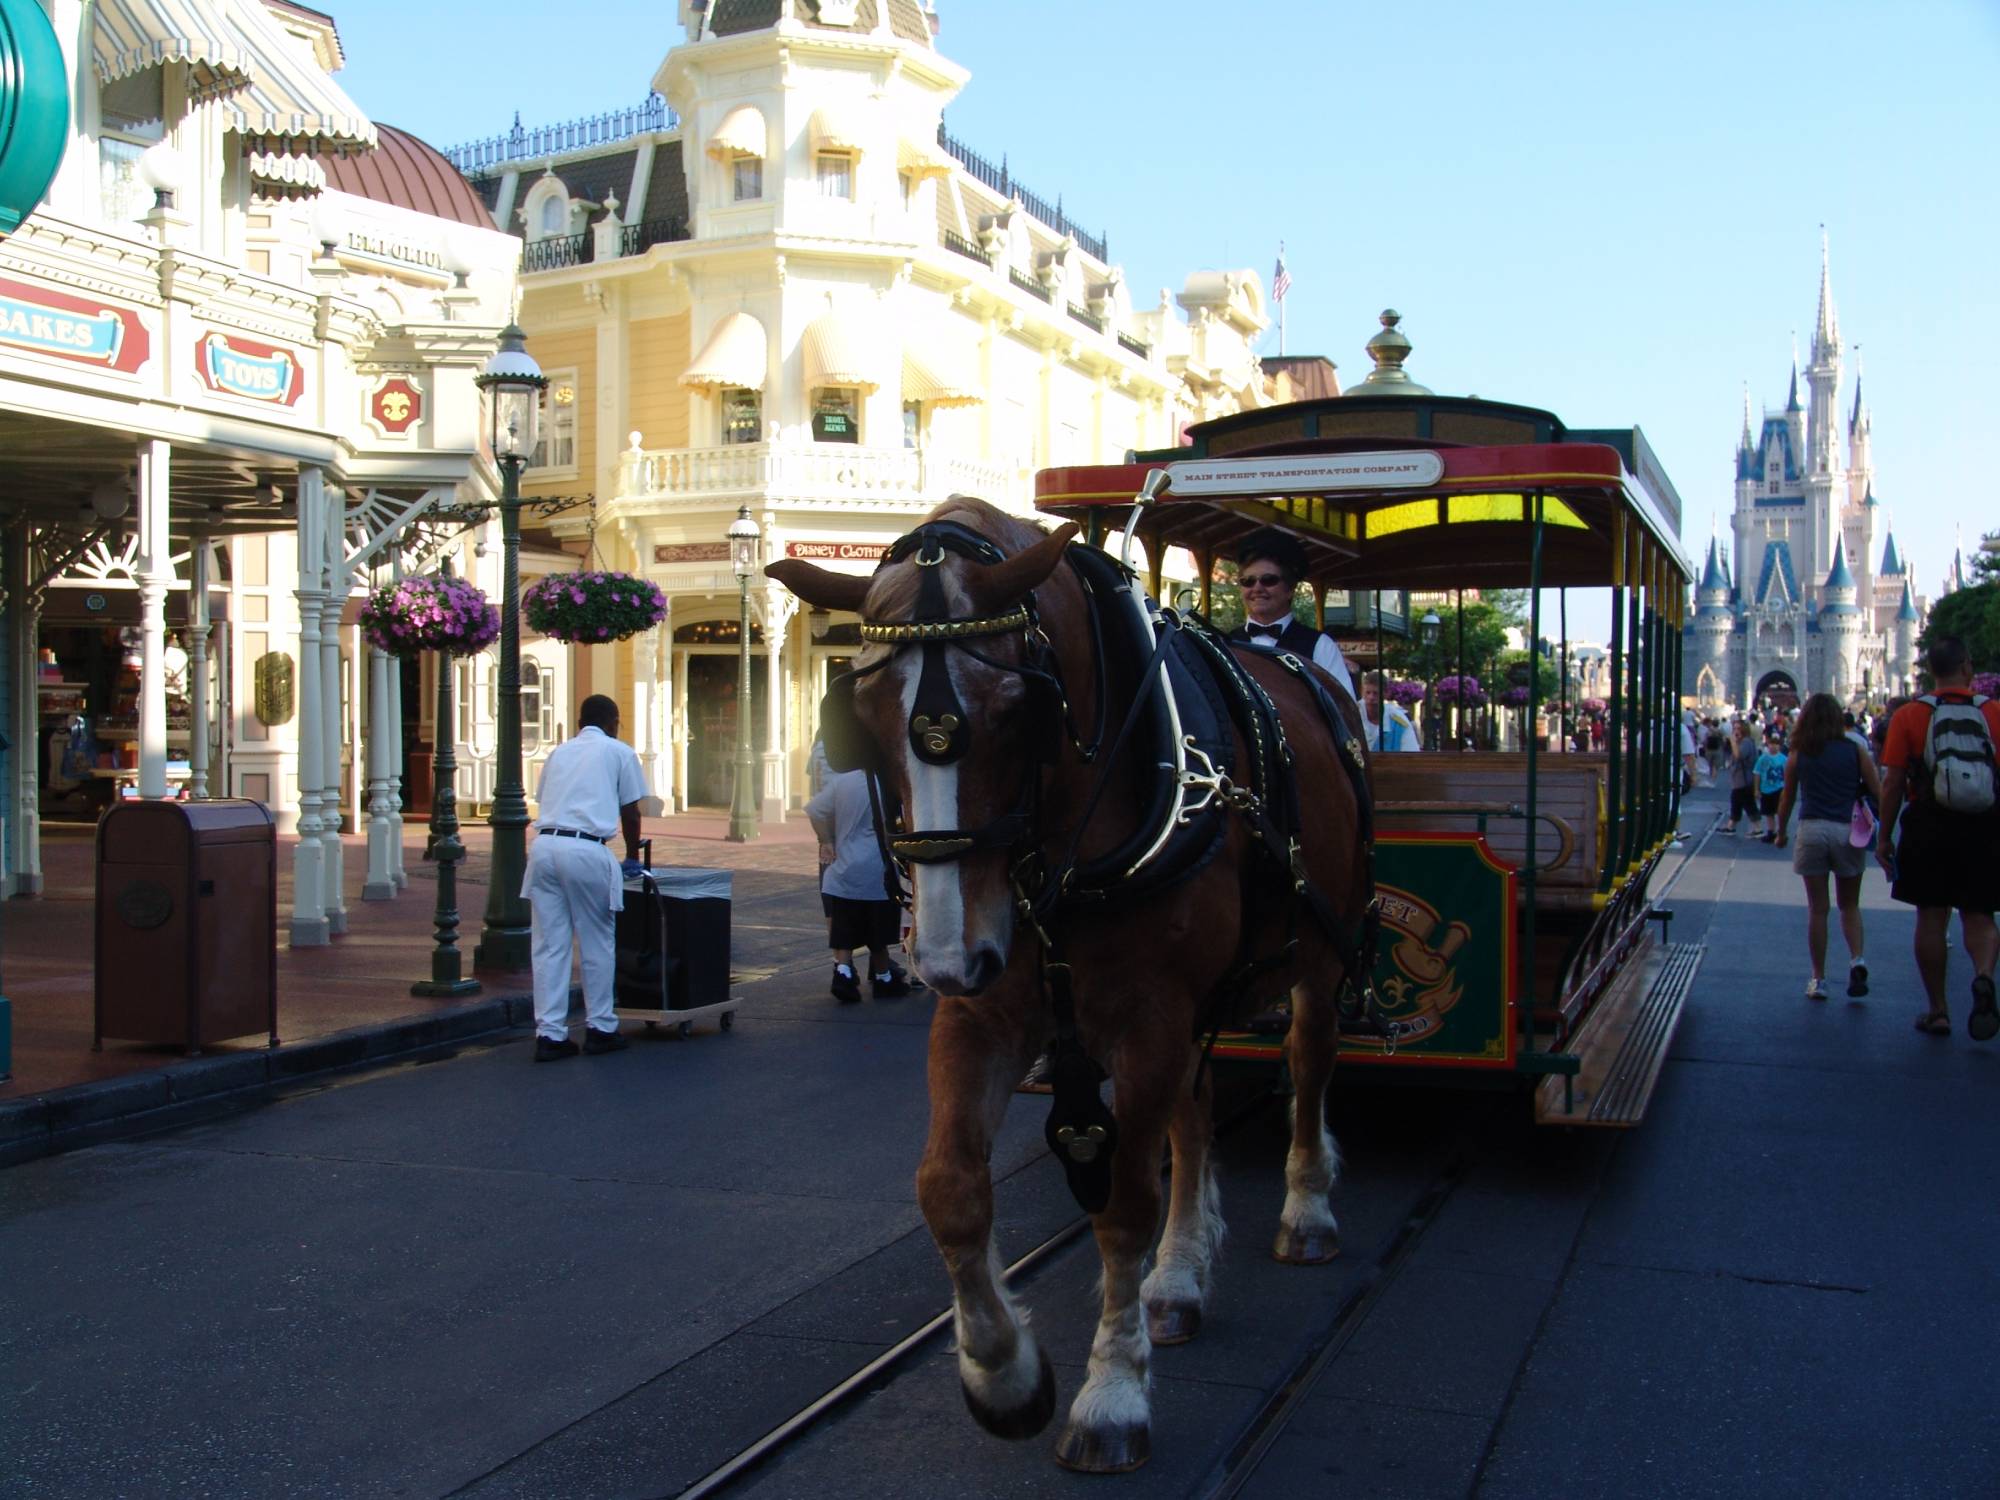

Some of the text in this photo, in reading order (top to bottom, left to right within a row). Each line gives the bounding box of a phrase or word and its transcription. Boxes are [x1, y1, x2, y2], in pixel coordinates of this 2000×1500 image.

[219, 357, 279, 390] TOYS
[1216, 471, 1258, 480] STREET
[1259, 467, 1361, 478] TRANSPORTATION
[1363, 464, 1420, 473] COMPANY
